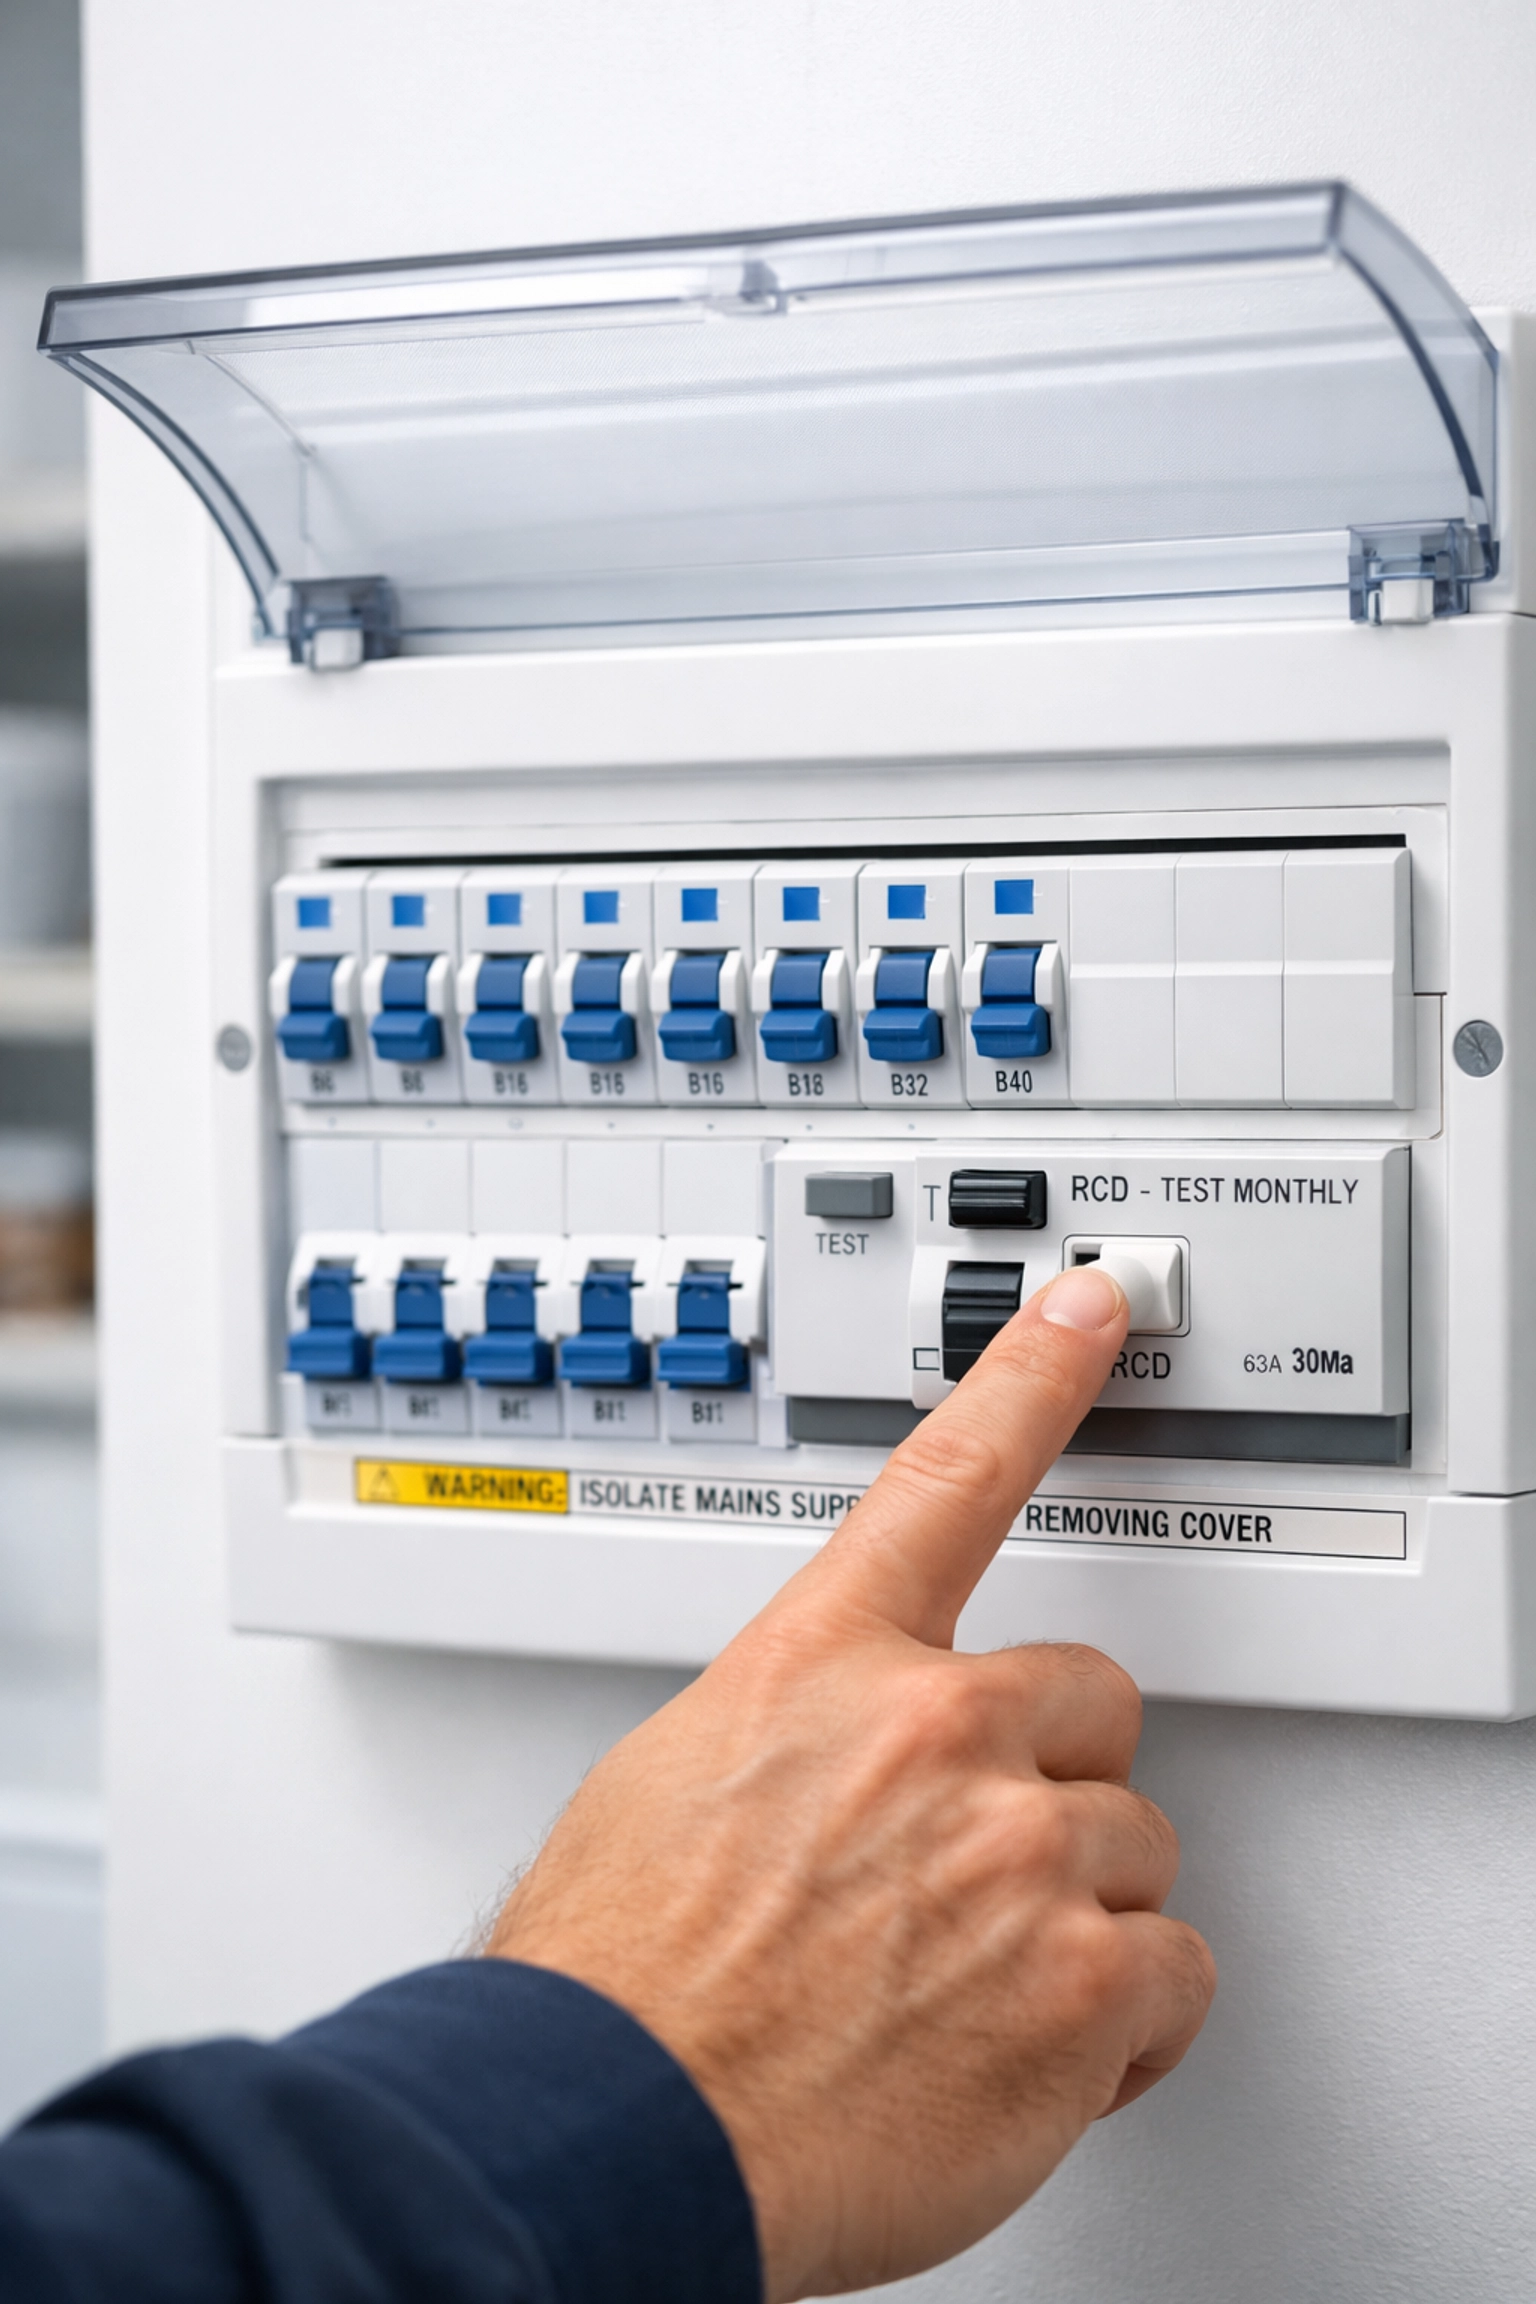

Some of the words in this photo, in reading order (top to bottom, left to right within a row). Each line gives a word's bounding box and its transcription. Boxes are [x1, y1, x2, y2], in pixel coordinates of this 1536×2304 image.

[688, 1072, 724, 1095] B16
[788, 1073, 824, 1096] B18
[890, 1073, 928, 1097] B32
[995, 1070, 1033, 1093] B40
[1071, 1175, 1129, 1202] RCD
[1161, 1177, 1225, 1203] TEST
[1234, 1178, 1359, 1204] MONTHLY
[815, 1233, 869, 1255] TEST
[1110, 1351, 1171, 1379] RCD
[1243, 1354, 1282, 1374] 63A
[1291, 1347, 1354, 1375] 30Ma
[580, 1479, 686, 1512] ISOLATE
[696, 1487, 781, 1517] MAINS
[1026, 1504, 1170, 1538] REMOVING
[1181, 1511, 1272, 1542] COVER
